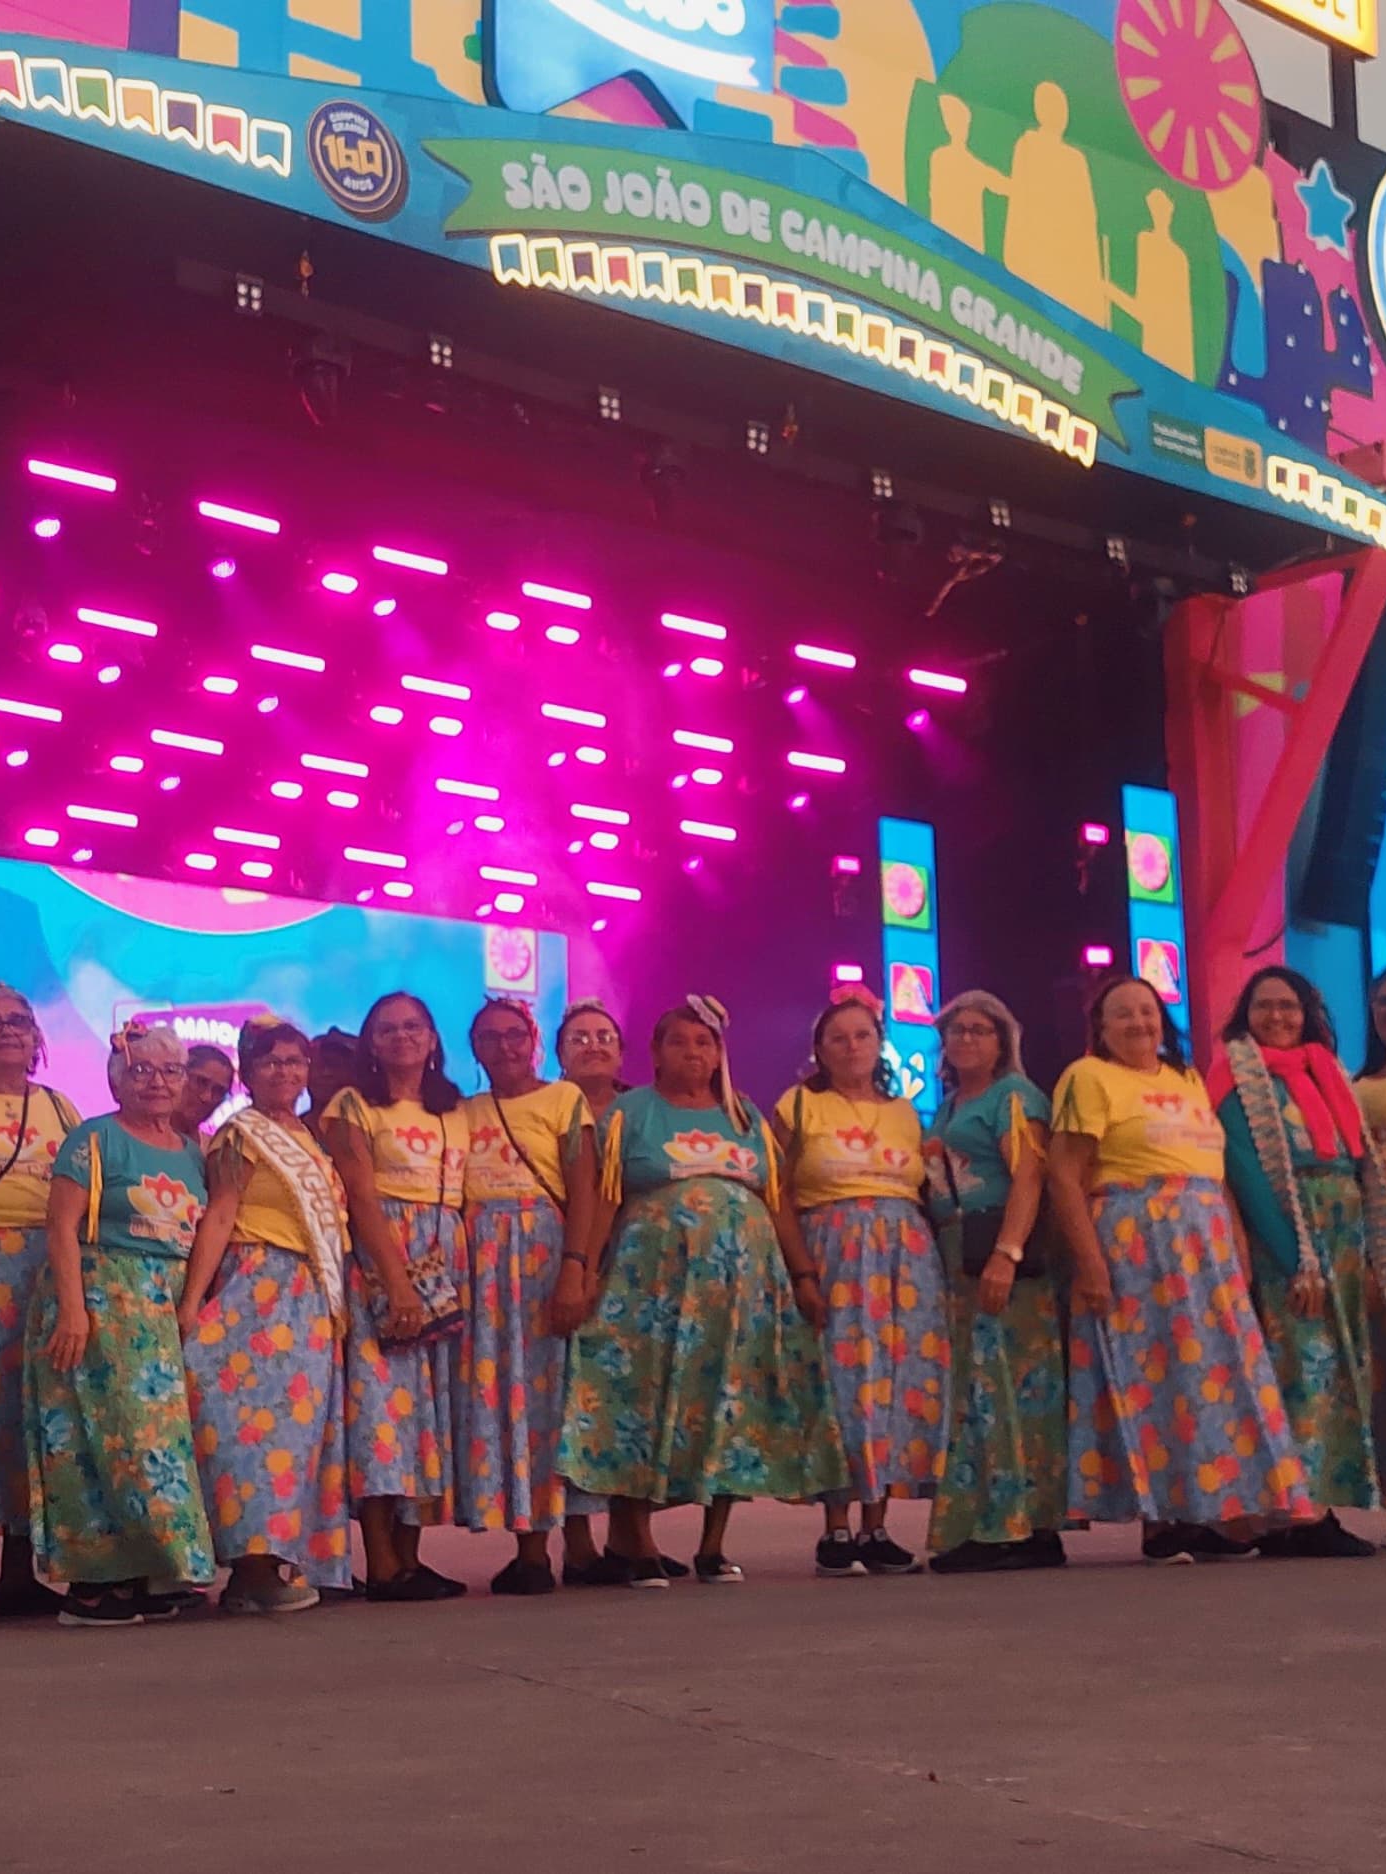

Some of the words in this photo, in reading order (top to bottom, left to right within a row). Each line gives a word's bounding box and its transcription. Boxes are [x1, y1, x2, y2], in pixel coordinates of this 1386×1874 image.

[323, 134, 384, 178] 160
[501, 153, 592, 211] SÃO
[603, 167, 712, 227] JOÃO
[720, 191, 772, 243] DE
[780, 209, 942, 312] CAMPINA
[949, 286, 1084, 395] GRANDE
